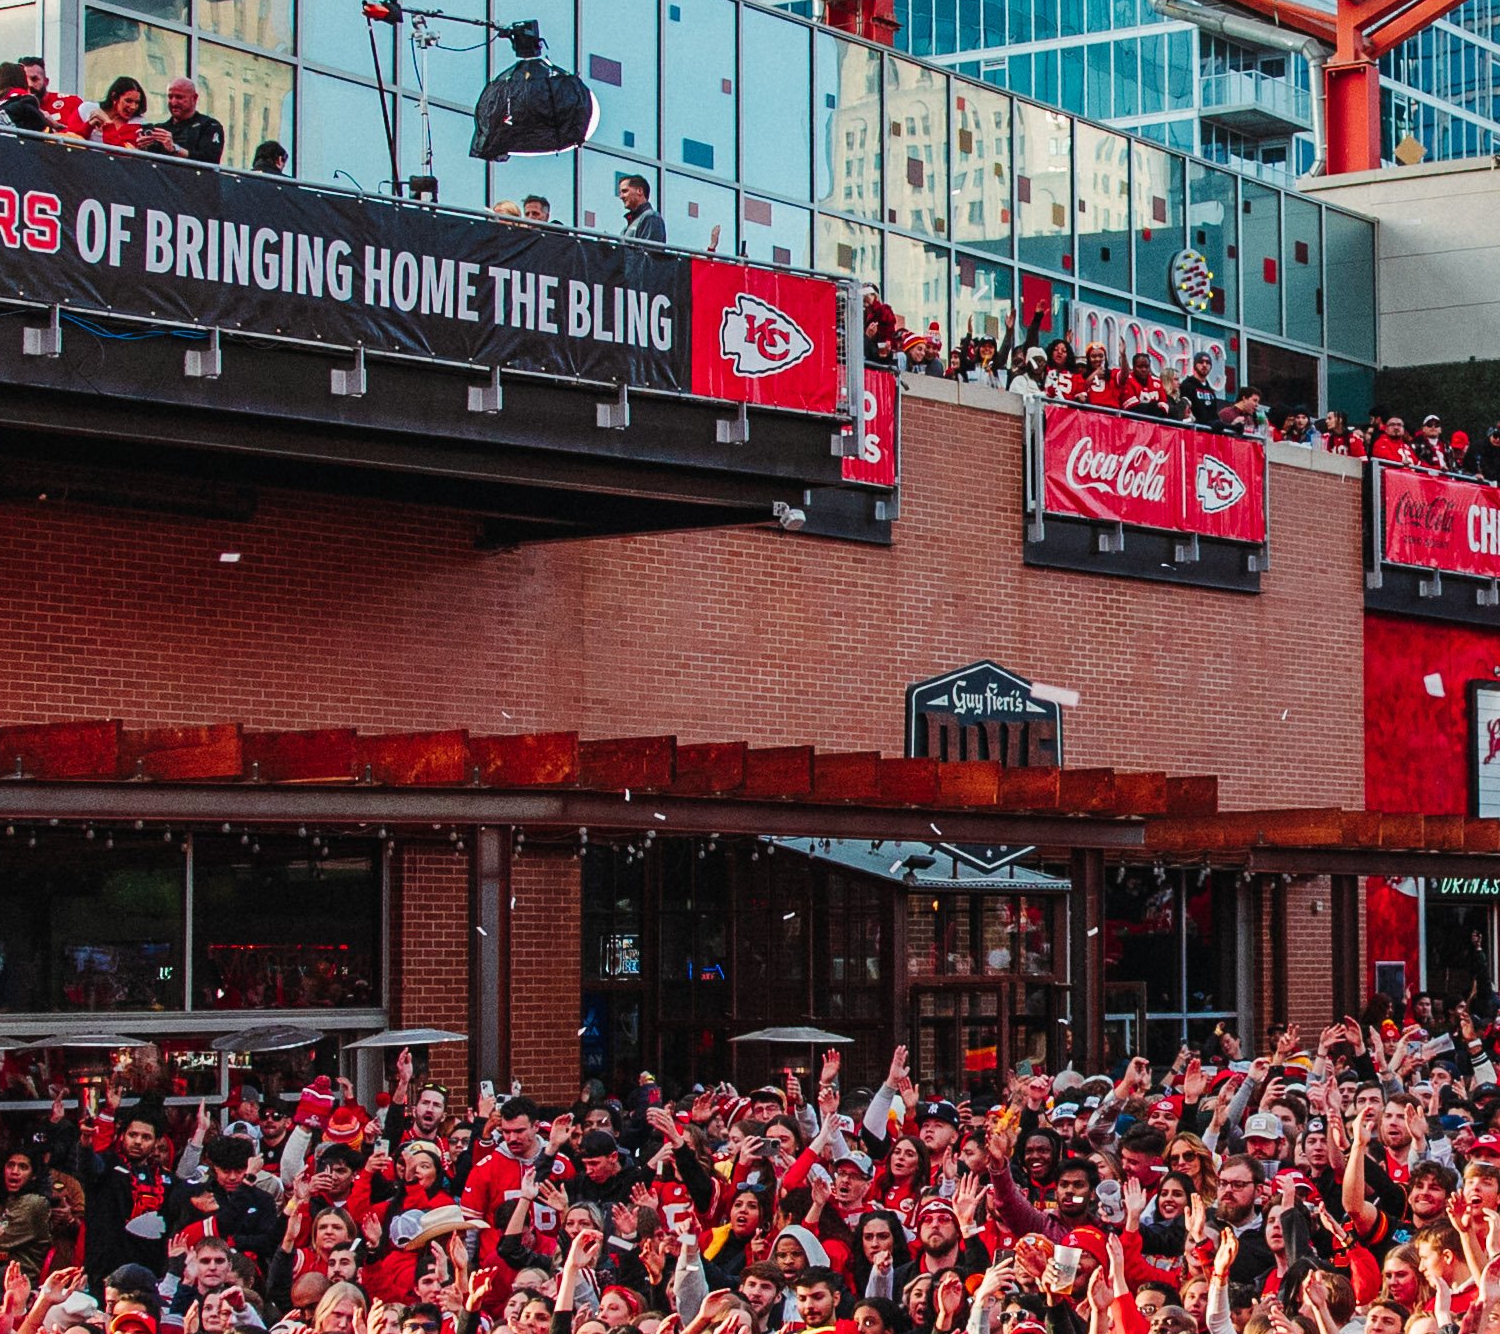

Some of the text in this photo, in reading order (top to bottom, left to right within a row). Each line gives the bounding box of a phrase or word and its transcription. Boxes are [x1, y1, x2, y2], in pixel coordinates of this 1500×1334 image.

[76, 198, 136, 267] OF
[146, 210, 354, 302] BRINGING
[363, 244, 480, 322] HOME
[488, 266, 559, 335] THE
[568, 279, 673, 352] BLING
[1065, 436, 1170, 501] Coca-Cola
[952, 679, 984, 716] Guy
